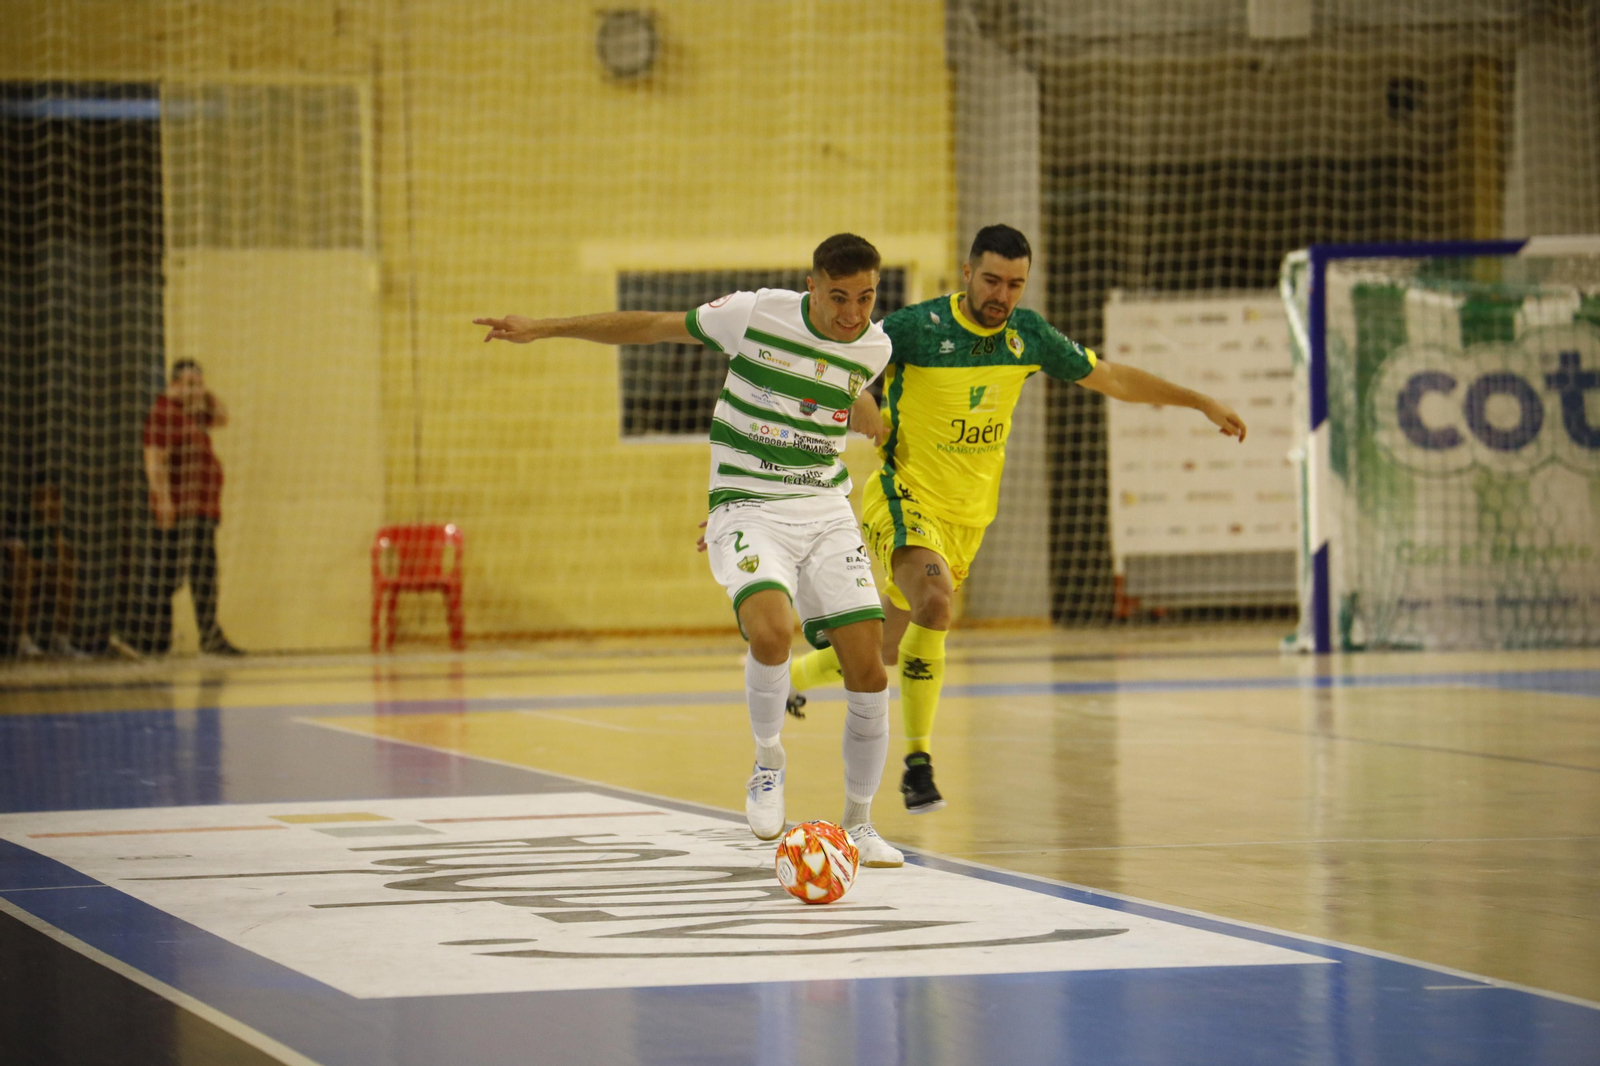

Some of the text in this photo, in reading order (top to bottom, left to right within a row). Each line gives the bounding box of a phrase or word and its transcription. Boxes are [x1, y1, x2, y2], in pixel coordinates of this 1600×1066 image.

[748, 432, 788, 448] CÓRDOBA
[950, 417, 1004, 444] Jaén
[728, 531, 750, 554] 2
[925, 563, 941, 577] 20
